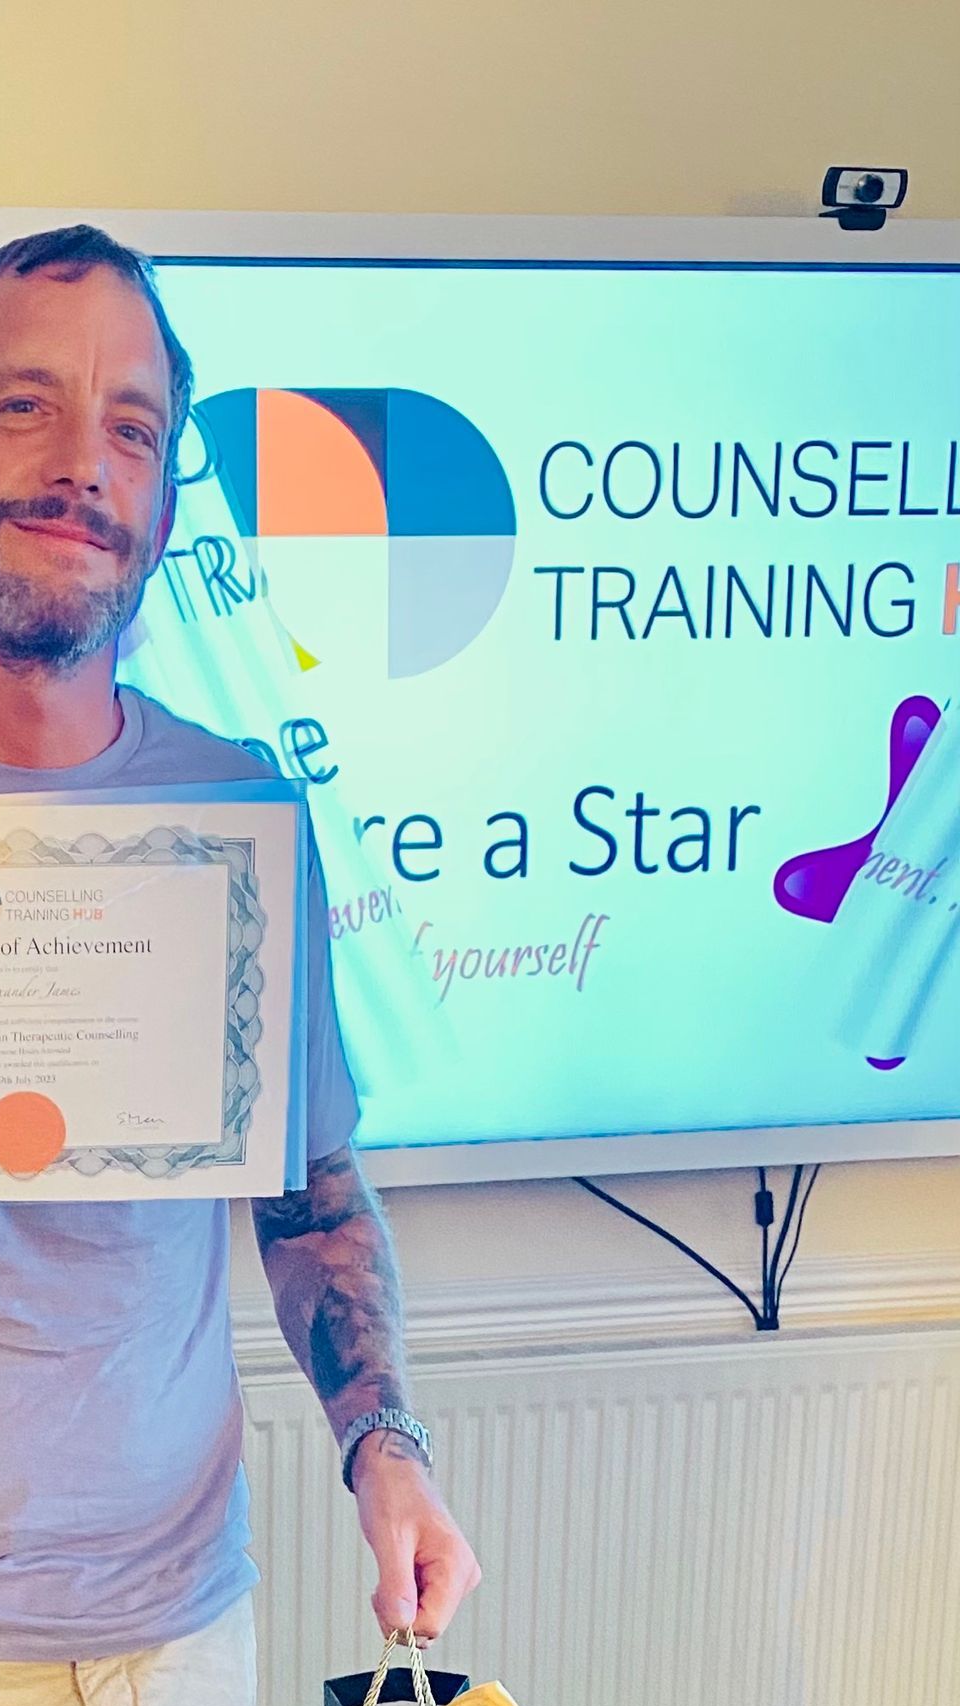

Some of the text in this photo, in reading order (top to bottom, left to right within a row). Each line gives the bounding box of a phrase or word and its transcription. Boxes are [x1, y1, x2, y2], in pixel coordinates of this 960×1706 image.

[534, 562, 915, 640] TRAINING
[483, 811, 528, 880] a
[568, 784, 761, 878] Star
[5, 889, 104, 904] COUNSELLING
[5, 907, 104, 922] TRAINING HUB
[0, 937, 23, 956] of
[26, 935, 152, 955] Achievement
[433, 913, 610, 1007] yourself
[40, 981, 81, 999] James
[12, 1031, 73, 1045] Therapeutic
[76, 1029, 139, 1042] Counselling
